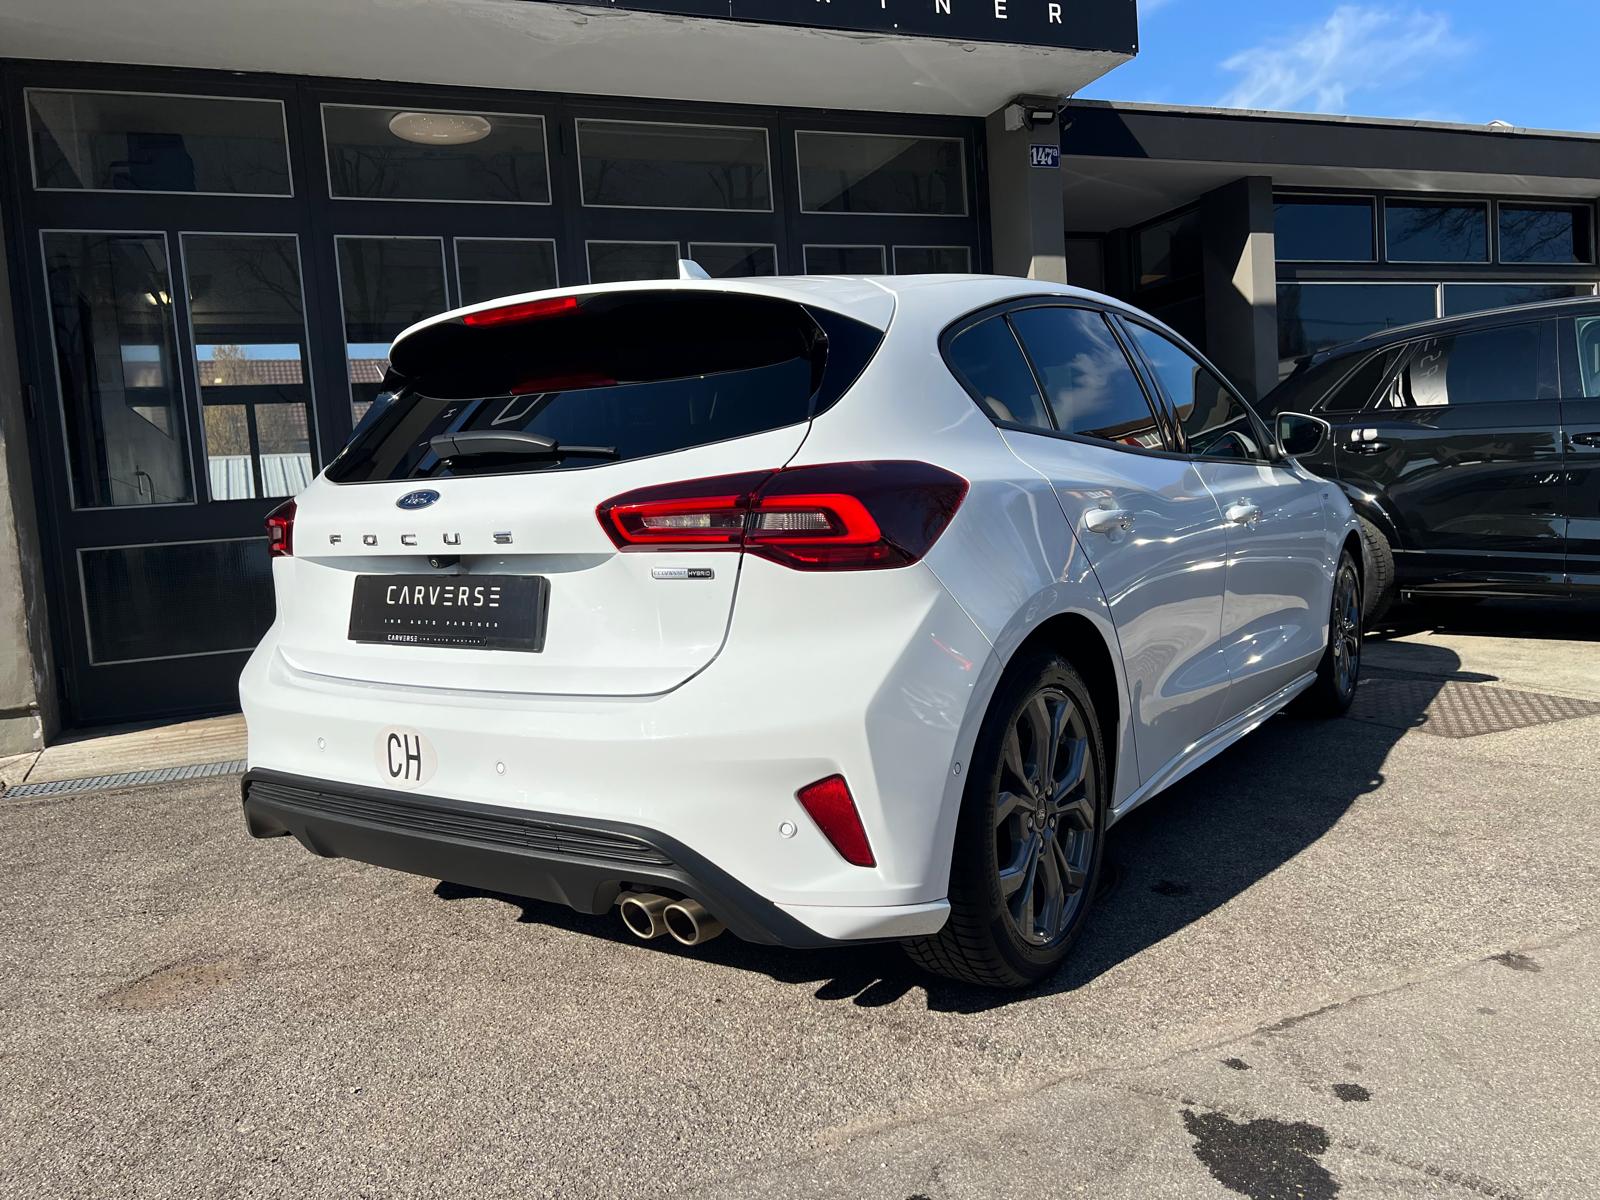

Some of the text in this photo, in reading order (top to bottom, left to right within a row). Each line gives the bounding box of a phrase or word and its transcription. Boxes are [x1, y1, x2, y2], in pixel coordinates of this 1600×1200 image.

[329, 531, 513, 546] FOCUS
[386, 585, 501, 607] CARVERSE
[387, 634, 418, 642] CARVERSE
[387, 733, 421, 781] CH
